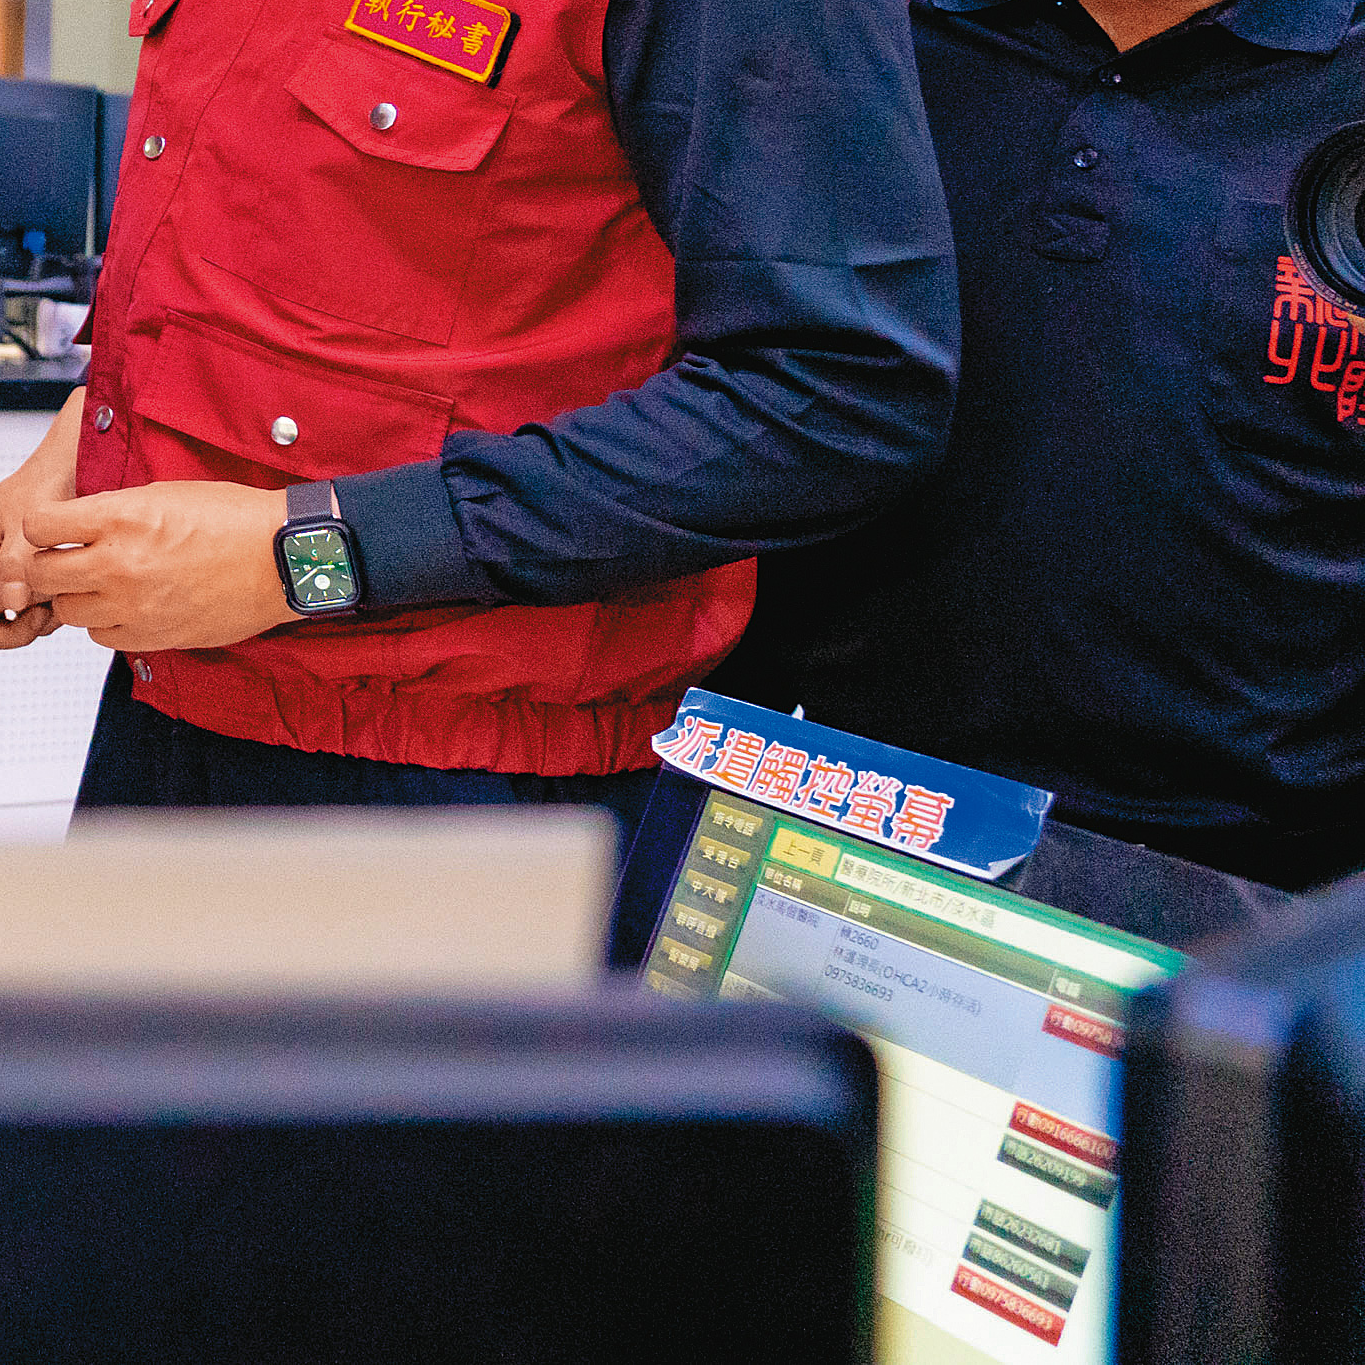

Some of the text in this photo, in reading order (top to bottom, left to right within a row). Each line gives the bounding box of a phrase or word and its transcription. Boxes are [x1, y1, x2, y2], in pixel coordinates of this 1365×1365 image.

[669, 715, 956, 851] 派遣觸控螢幕
